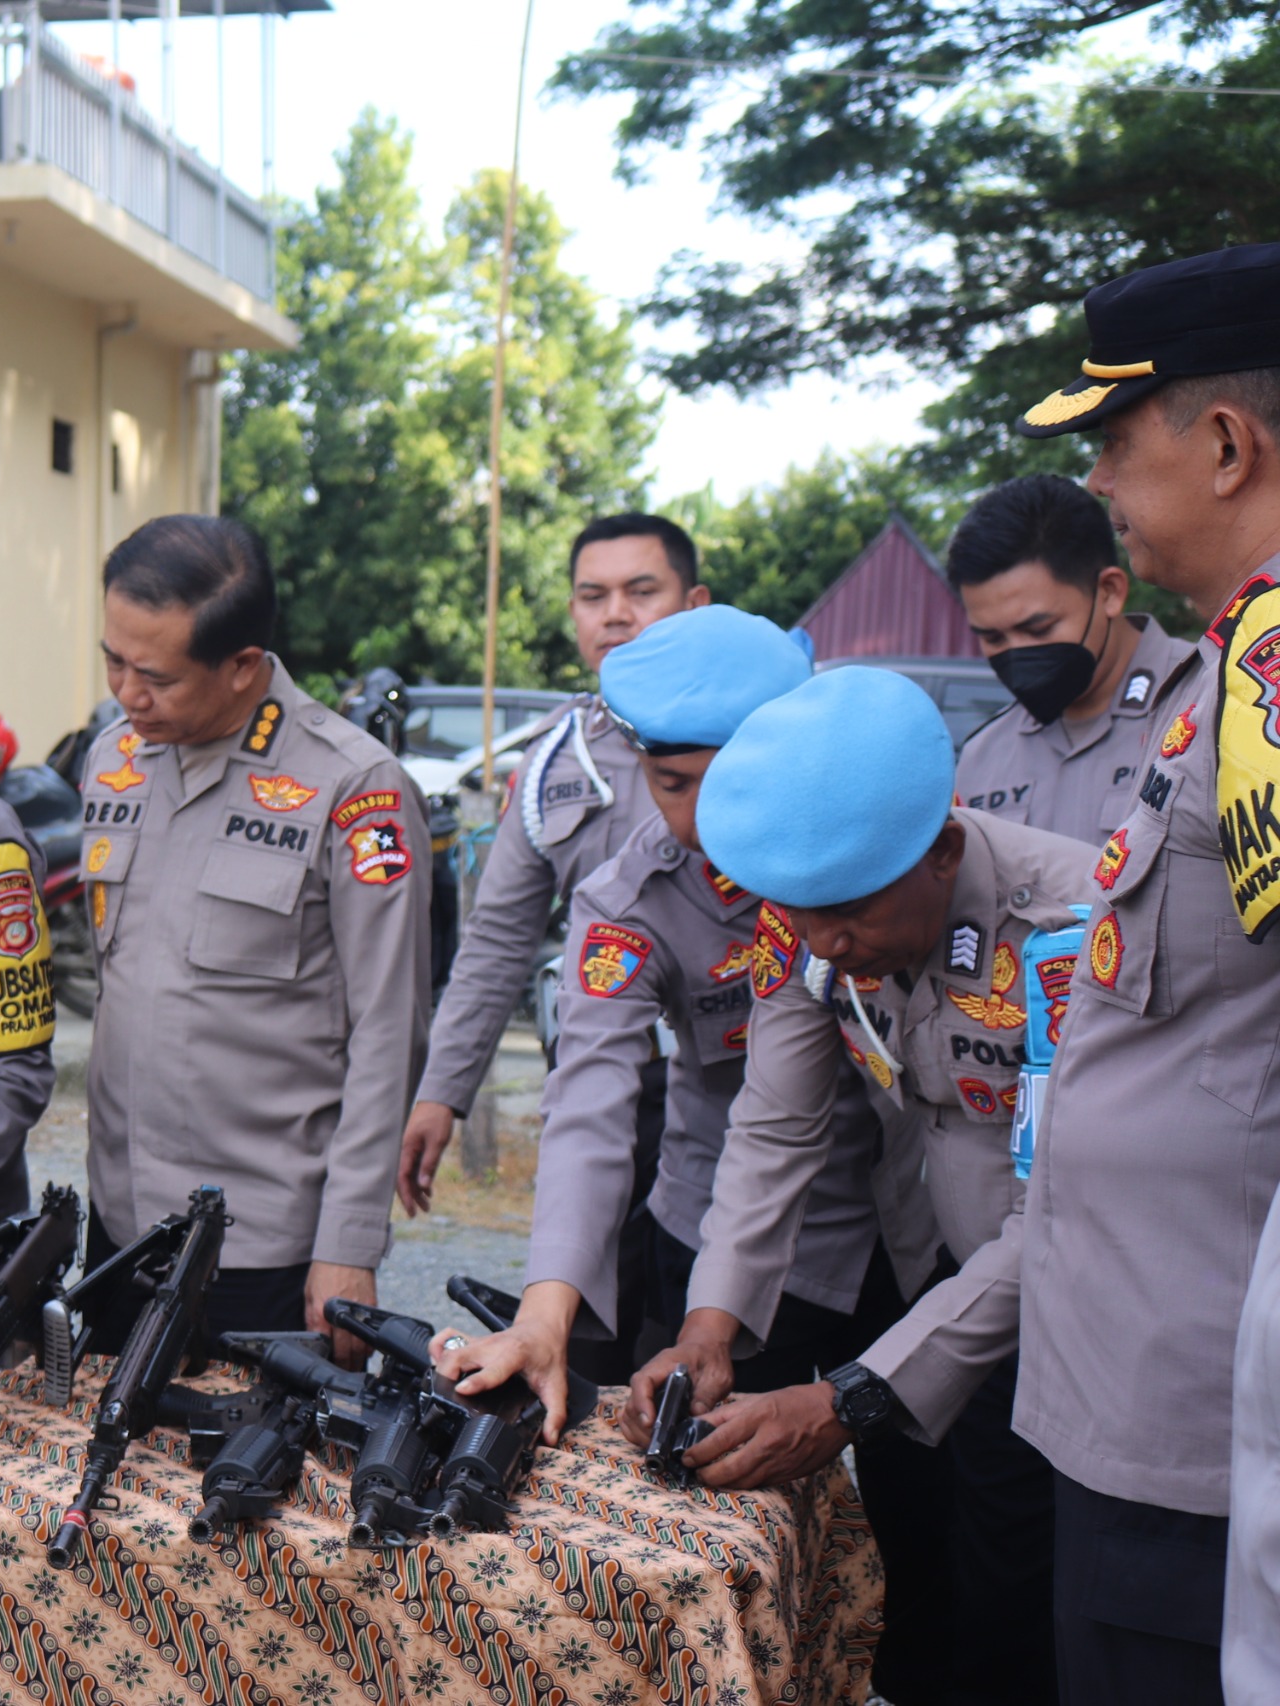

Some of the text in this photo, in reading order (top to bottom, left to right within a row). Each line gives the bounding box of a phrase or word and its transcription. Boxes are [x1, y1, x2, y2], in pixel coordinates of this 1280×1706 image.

[547, 781, 582, 803] CRIS
[85, 801, 141, 824] DEDI
[337, 794, 395, 823] ITWASUM
[226, 814, 308, 852] POLRI
[599, 926, 642, 947] PROPAM
